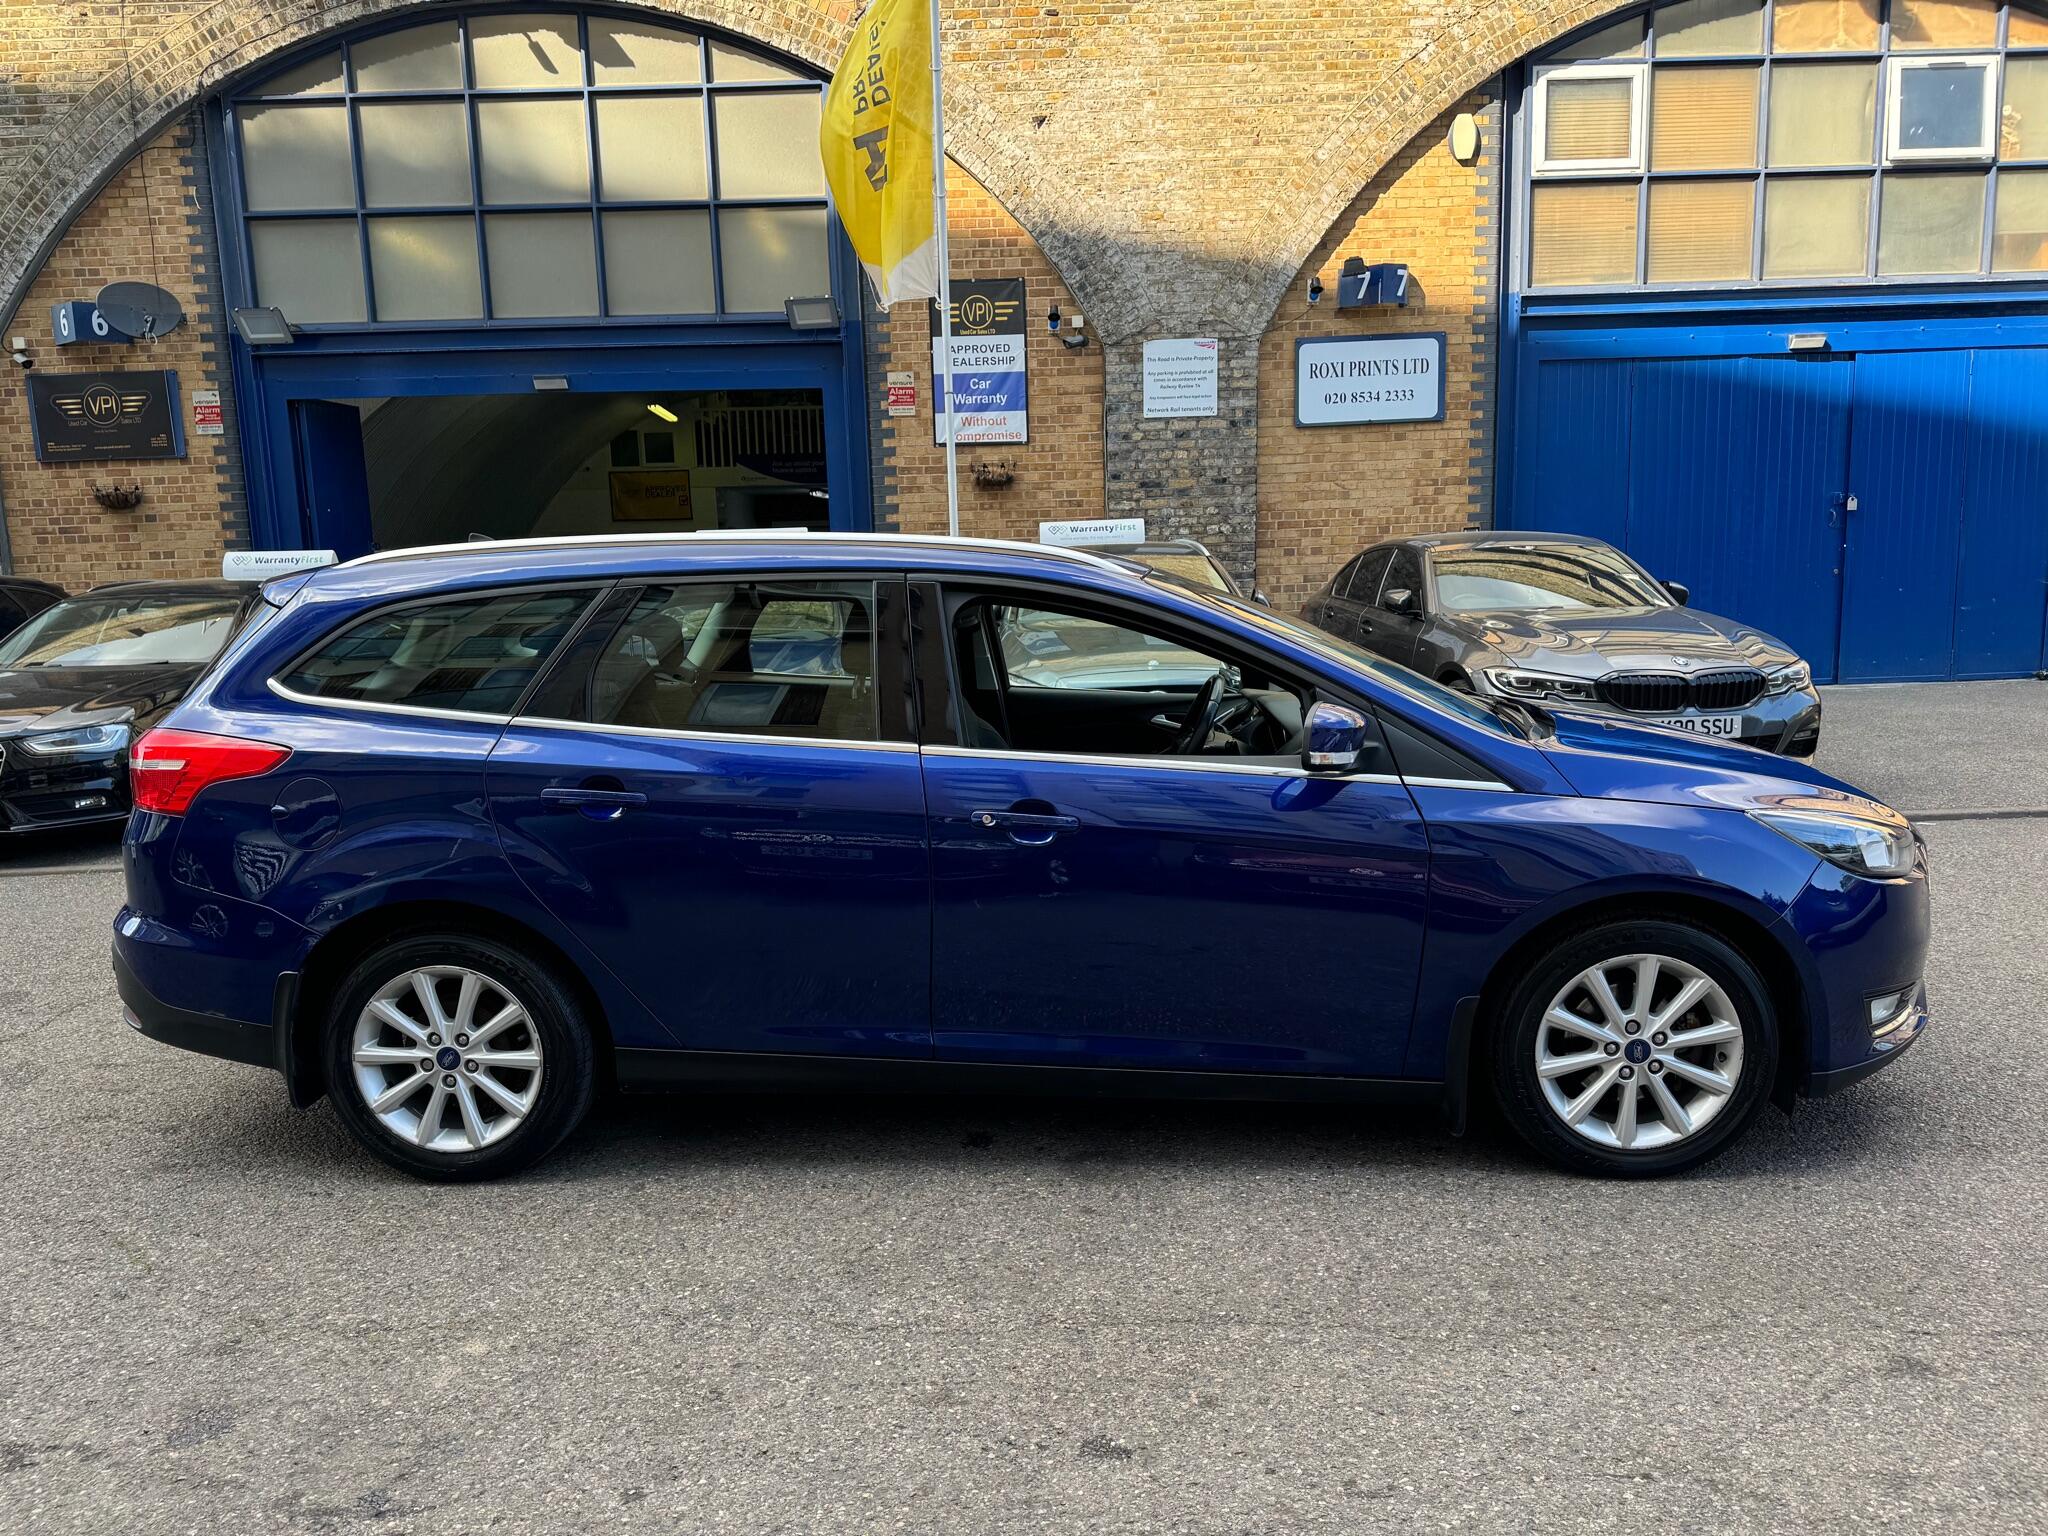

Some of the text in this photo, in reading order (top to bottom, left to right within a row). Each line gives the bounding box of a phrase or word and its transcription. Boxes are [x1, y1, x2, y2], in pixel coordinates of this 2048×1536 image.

[1357, 271, 1371, 300] 7
[1396, 269, 1408, 297] 7
[965, 302, 989, 322] VPI
[59, 307, 69, 338] 6
[91, 310, 110, 336] 6
[950, 343, 1011, 354] APPROVED
[952, 356, 1016, 367] EALERSHIP
[1309, 357, 1430, 380] ROXI PRINTS LTD
[889, 387, 914, 395] Alarm
[969, 378, 992, 389] Car
[953, 393, 1008, 406] Warranty
[1324, 389, 1415, 405] 020 8534 2333
[88, 395, 117, 416] VPI
[196, 406, 221, 414] Alarm
[960, 416, 1007, 427] Without
[955, 431, 1022, 442] ompromise
[1701, 717, 1734, 736] SSU
